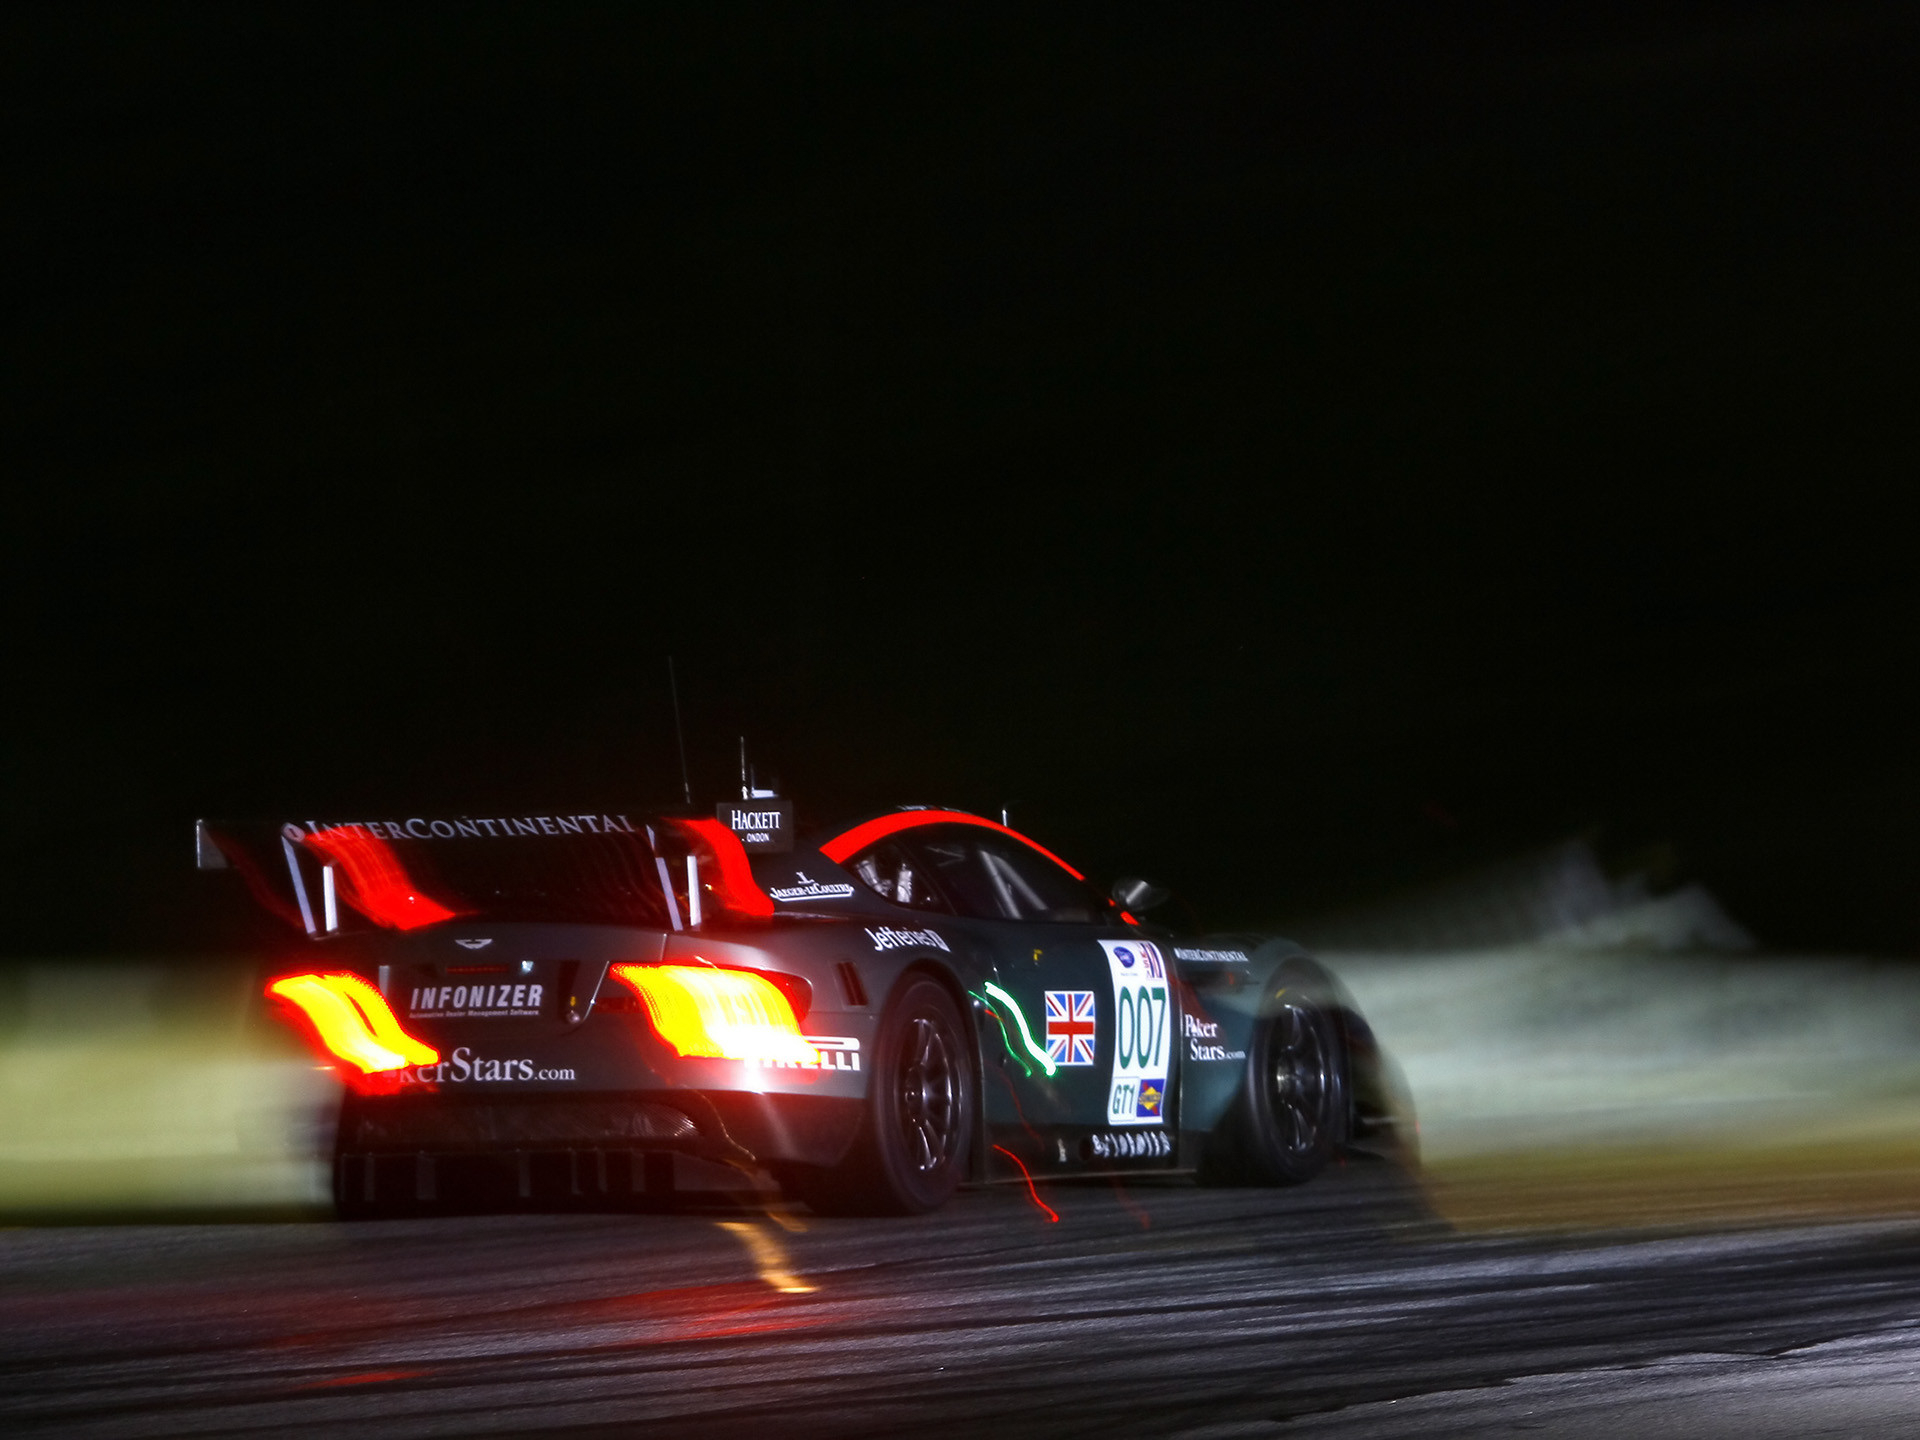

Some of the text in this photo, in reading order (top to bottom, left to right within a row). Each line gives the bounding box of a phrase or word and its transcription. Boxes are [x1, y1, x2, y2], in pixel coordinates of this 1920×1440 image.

[731, 809, 781, 830] HACKETT
[741, 832, 770, 843] ONDON
[410, 984, 543, 1010] INFONIZER
[1119, 986, 1166, 1070] 007
[1190, 1038, 1246, 1061] Stars.com
[1112, 1084, 1136, 1114] GT1
